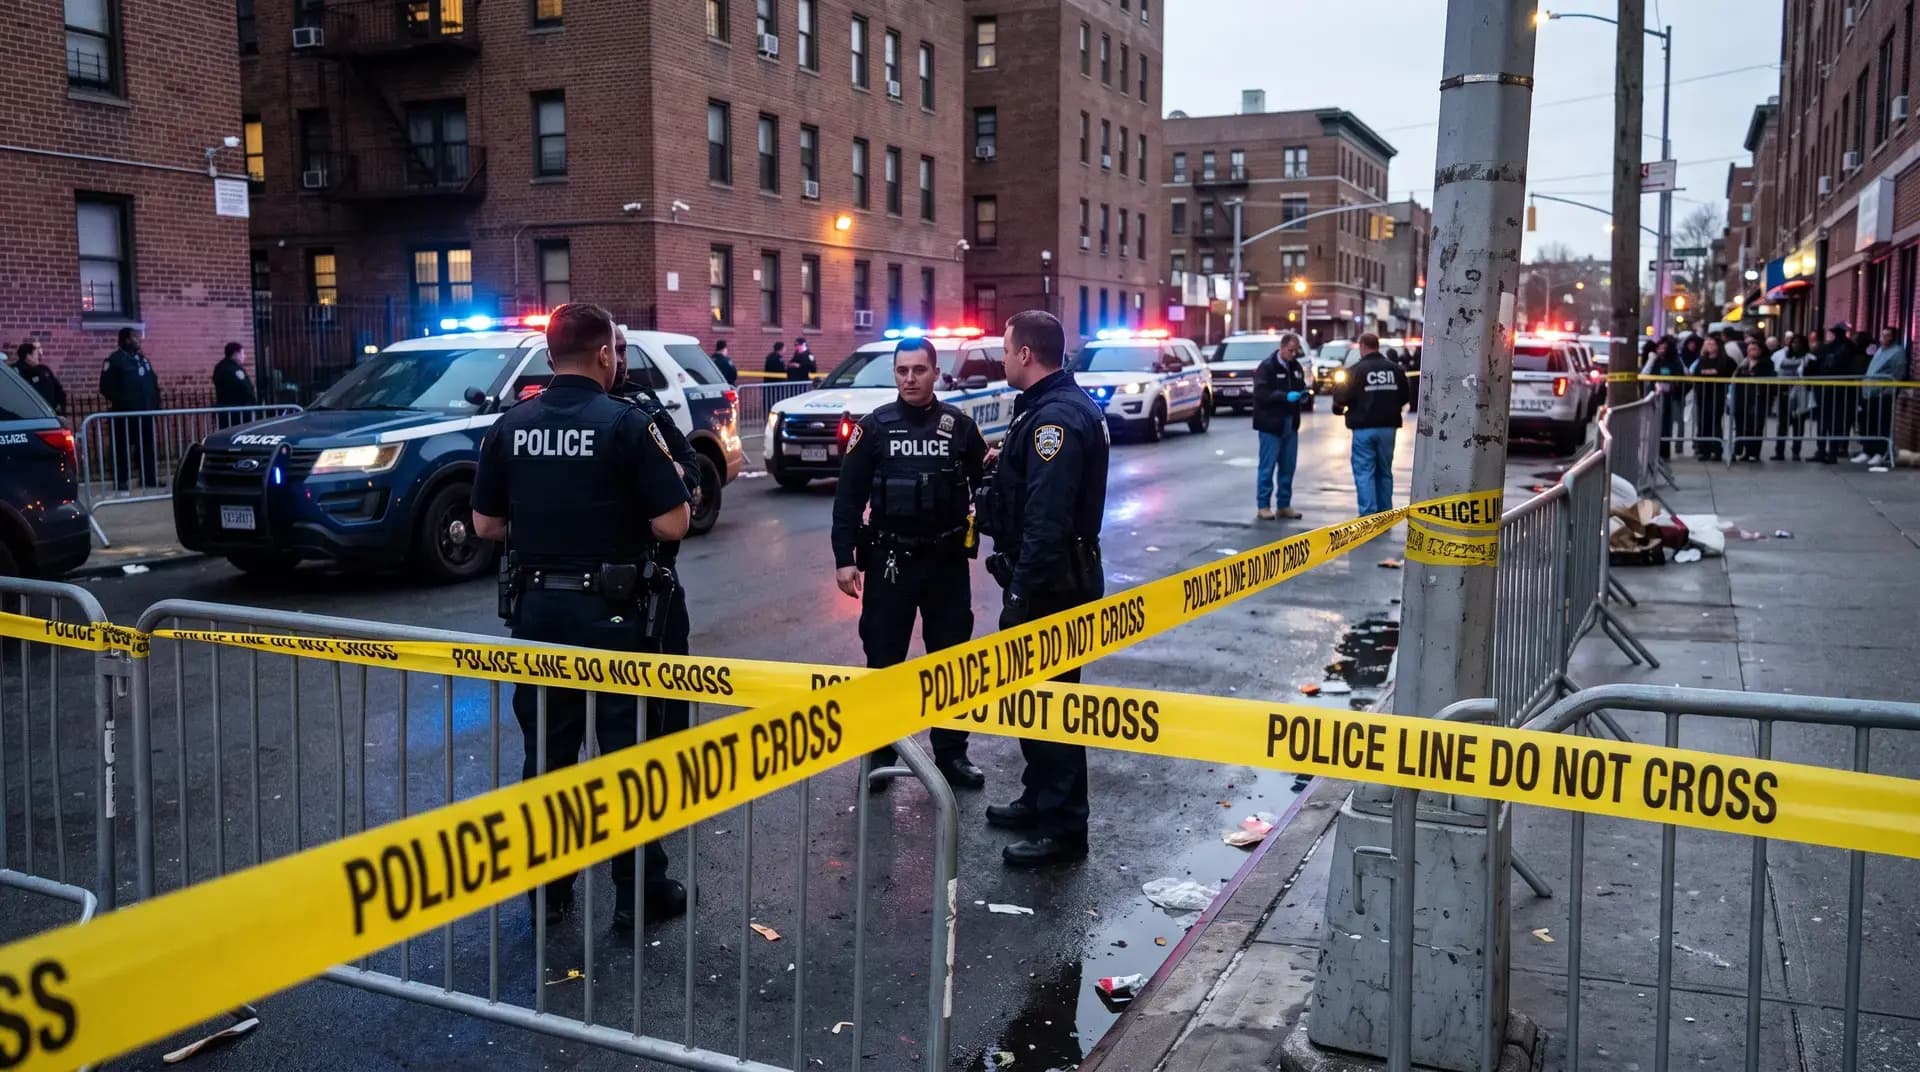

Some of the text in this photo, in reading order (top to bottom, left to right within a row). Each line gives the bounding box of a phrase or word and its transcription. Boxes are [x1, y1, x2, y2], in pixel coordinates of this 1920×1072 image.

[232, 435, 286, 445] POLICE
[513, 429, 595, 456] POLICE
[890, 440, 950, 456] POLICE
[1183, 538, 1311, 613] POLICE LINE DO NOT CROSS
[452, 648, 734, 697] POLICE LINE DO NOT CROSS
[919, 595, 1145, 717] POLICE LINE DO NOT CROSS
[998, 688, 1053, 730] NOT
[1062, 692, 1160, 743] CROSS
[1266, 713, 1779, 825] POLICE LINE DO NOT CROSS
[344, 699, 844, 936] POLICE LINE DO NOT CROSS
